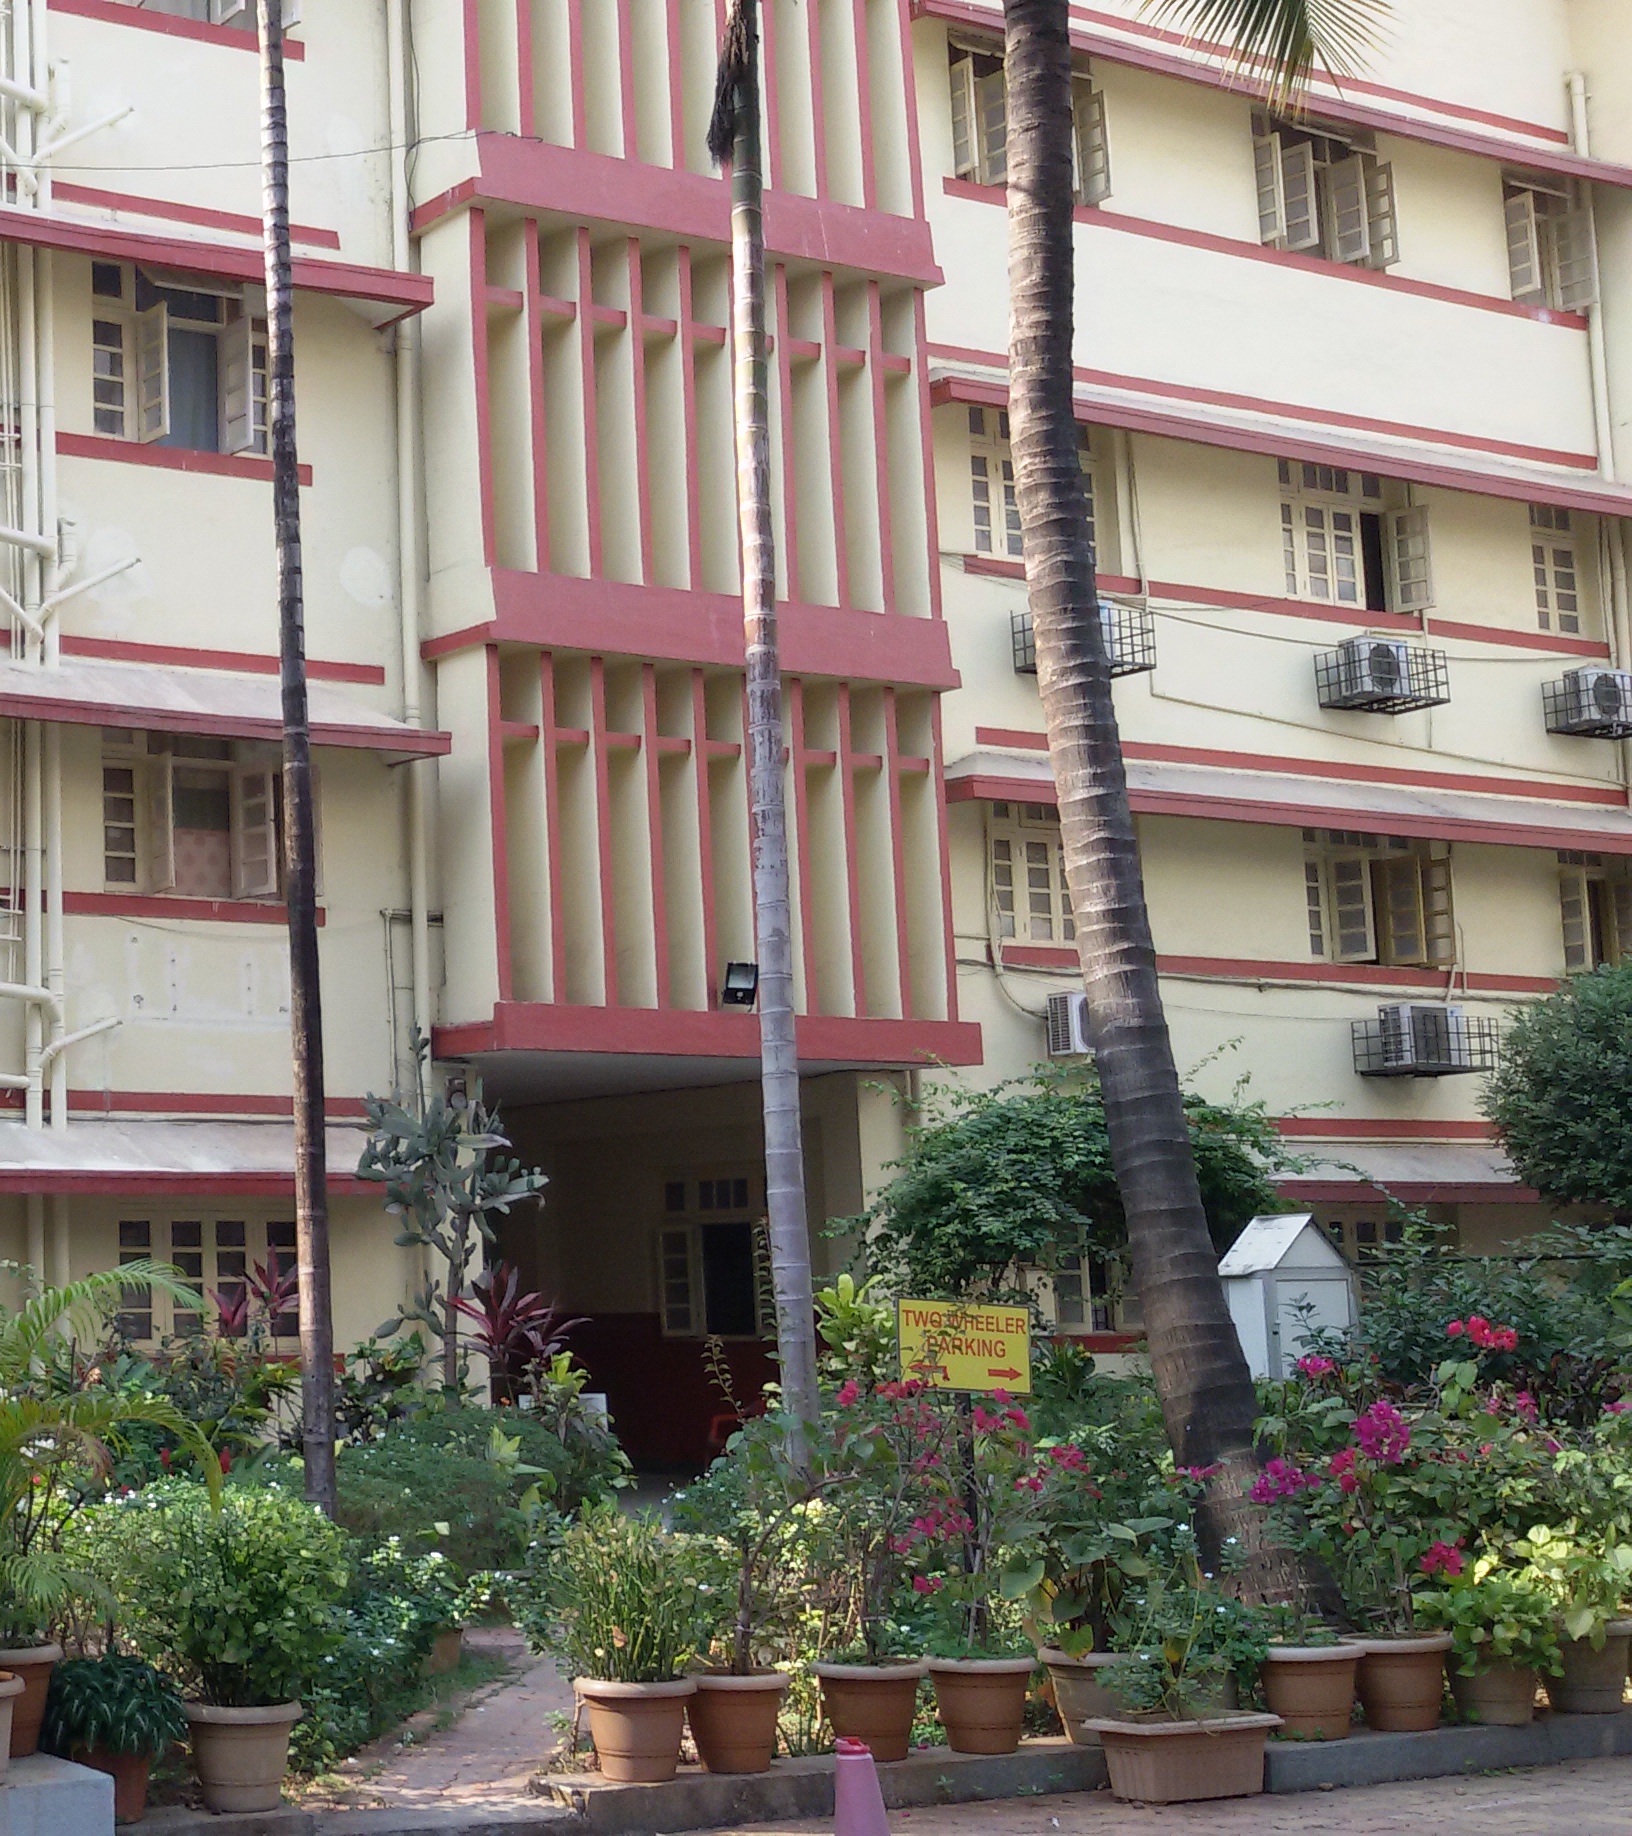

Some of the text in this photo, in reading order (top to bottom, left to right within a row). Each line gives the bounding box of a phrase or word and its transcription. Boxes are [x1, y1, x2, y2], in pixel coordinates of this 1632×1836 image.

[902, 1309, 1027, 1335] TWO WHEELER
[926, 1335, 1006, 1359] PARKING
